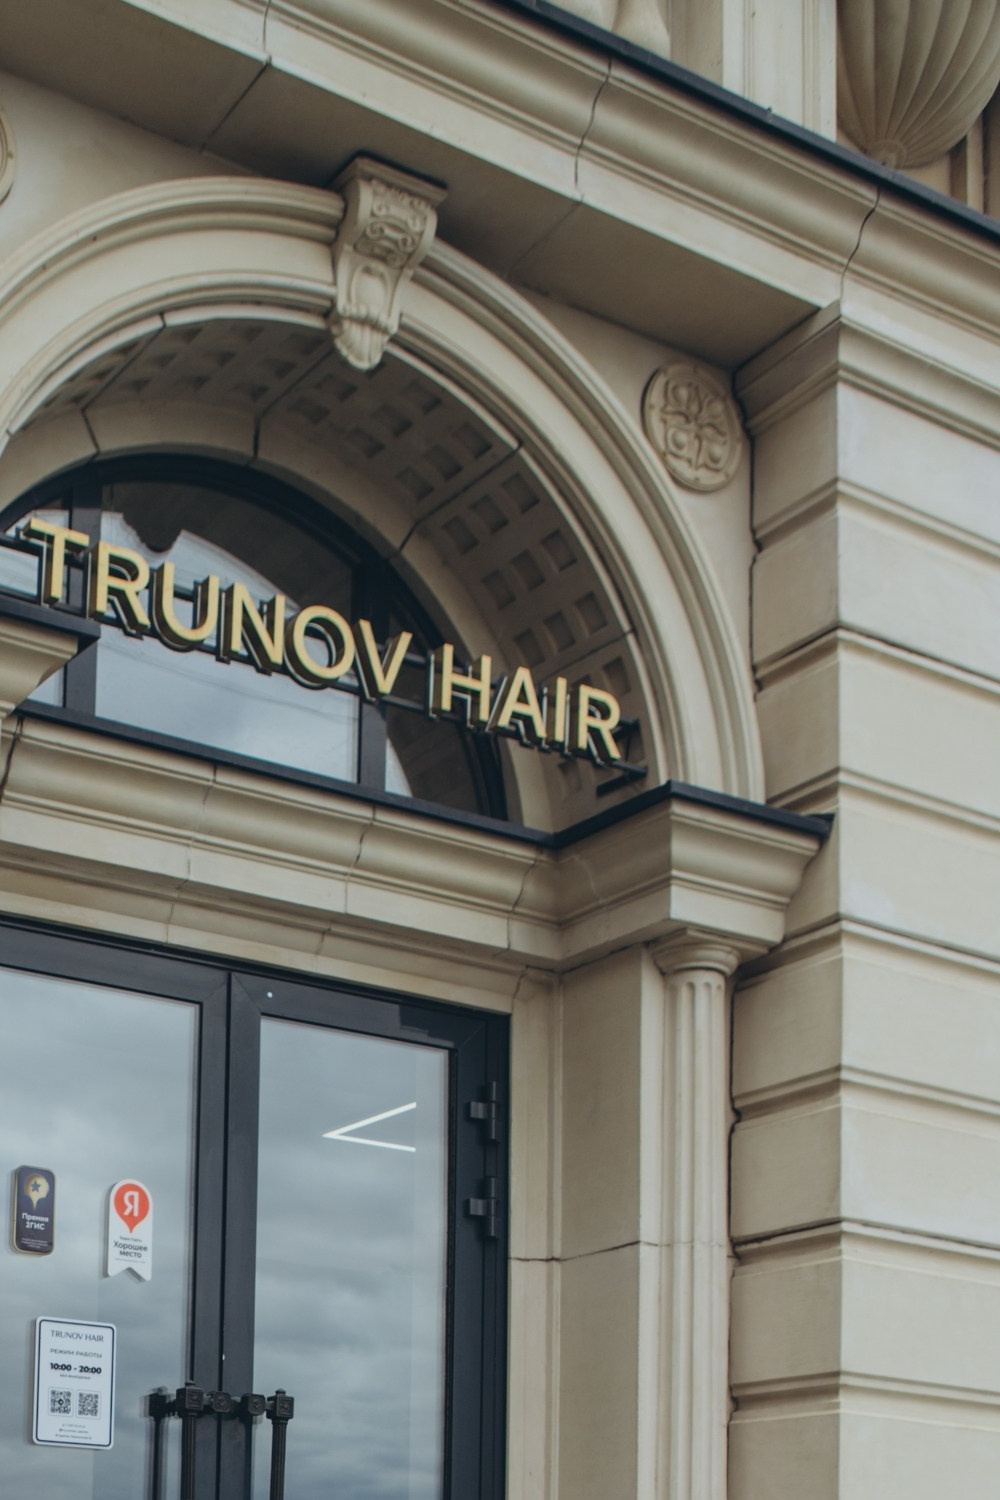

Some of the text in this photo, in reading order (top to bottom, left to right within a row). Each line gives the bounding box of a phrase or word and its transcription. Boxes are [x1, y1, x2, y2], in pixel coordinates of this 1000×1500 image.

[22, 516, 623, 762] TRUNOV HAIR
[123, 1190, 139, 1217] Я
[22, 1212, 49, 1222] Премия
[25, 1221, 45, 1230] 2ГИС
[113, 1240, 148, 1252] Хорошее
[119, 1250, 142, 1258] место
[51, 1330, 104, 1342] TRUNOV HAIR
[75, 1350, 102, 1358] РАБОТЫ
[50, 1362, 72, 1371] 10:00
[79, 1365, 102, 1374] 20:00
